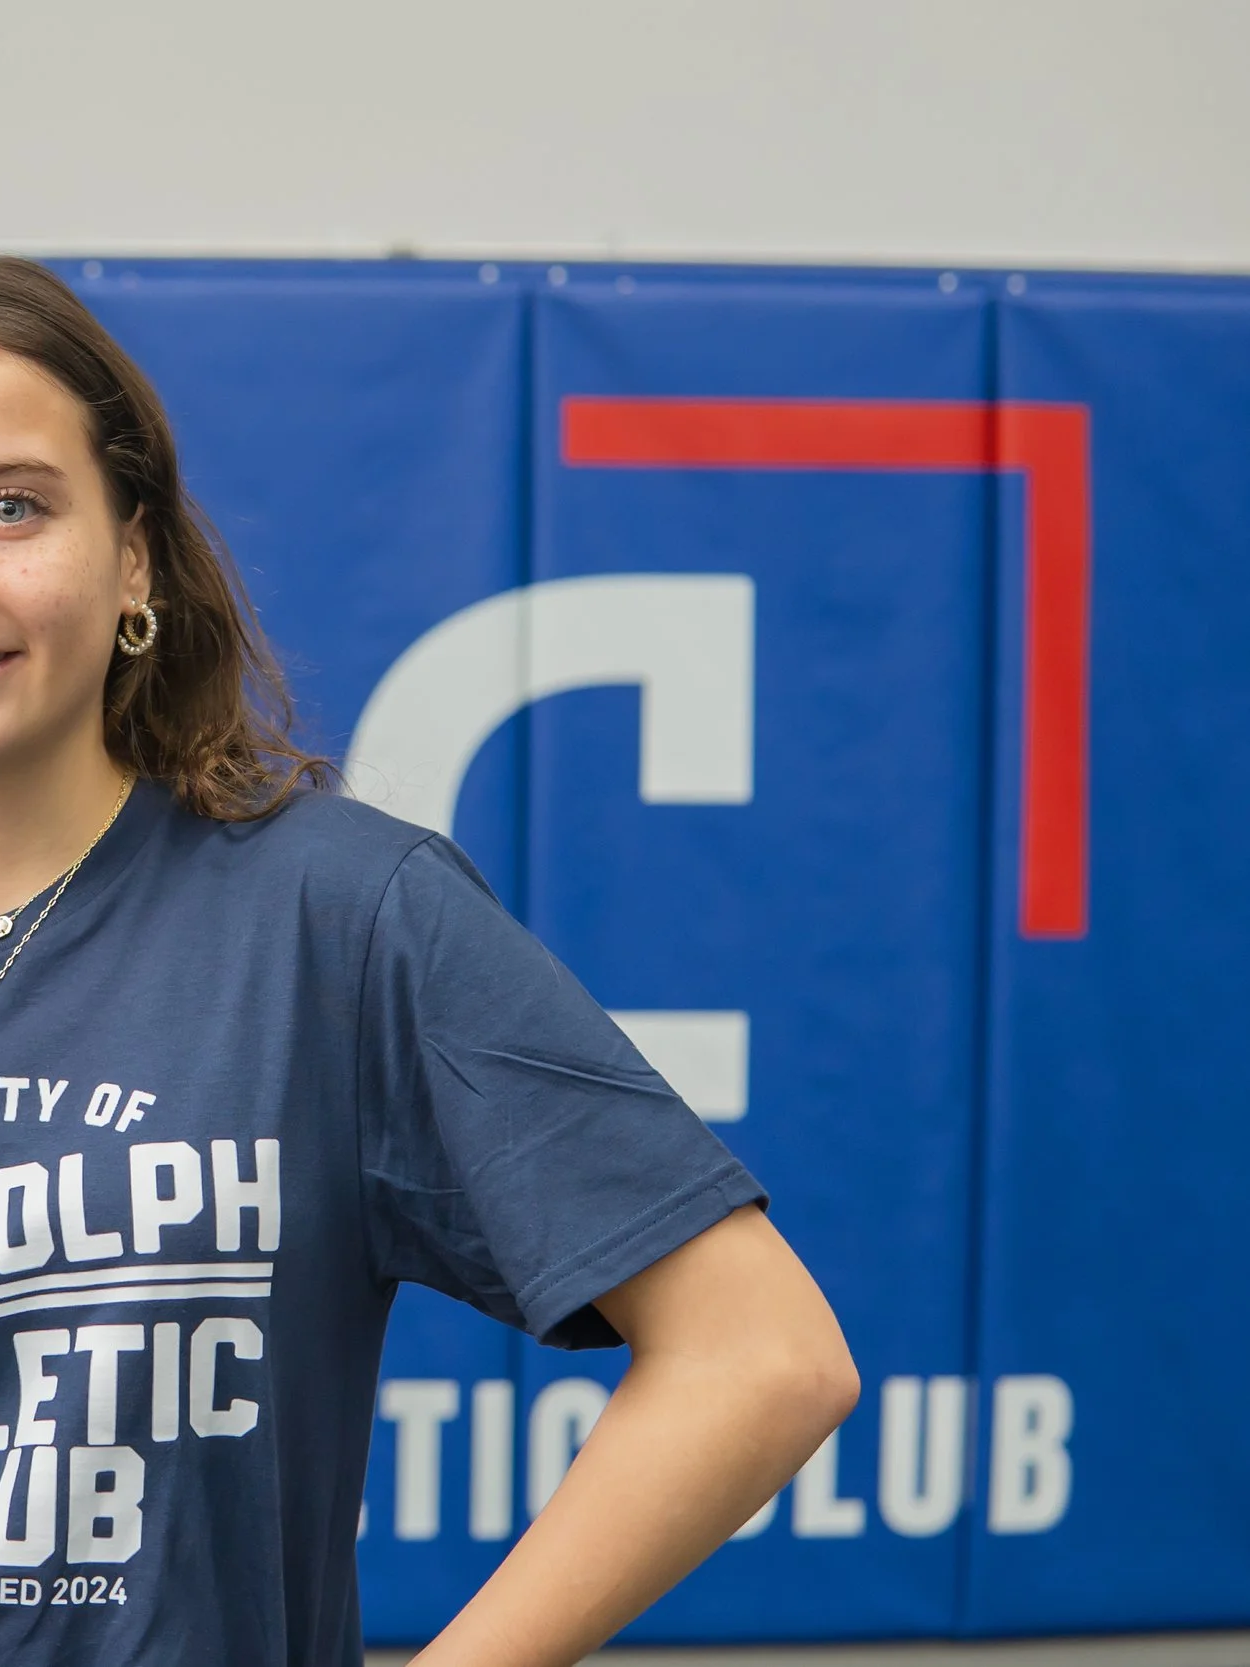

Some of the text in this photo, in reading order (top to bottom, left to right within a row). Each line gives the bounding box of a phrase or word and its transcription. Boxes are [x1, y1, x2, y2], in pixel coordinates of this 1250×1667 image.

[83, 1081, 157, 1133] OF
[726, 1373, 1076, 1540] LUB
[50, 1576, 128, 1606] 2024
